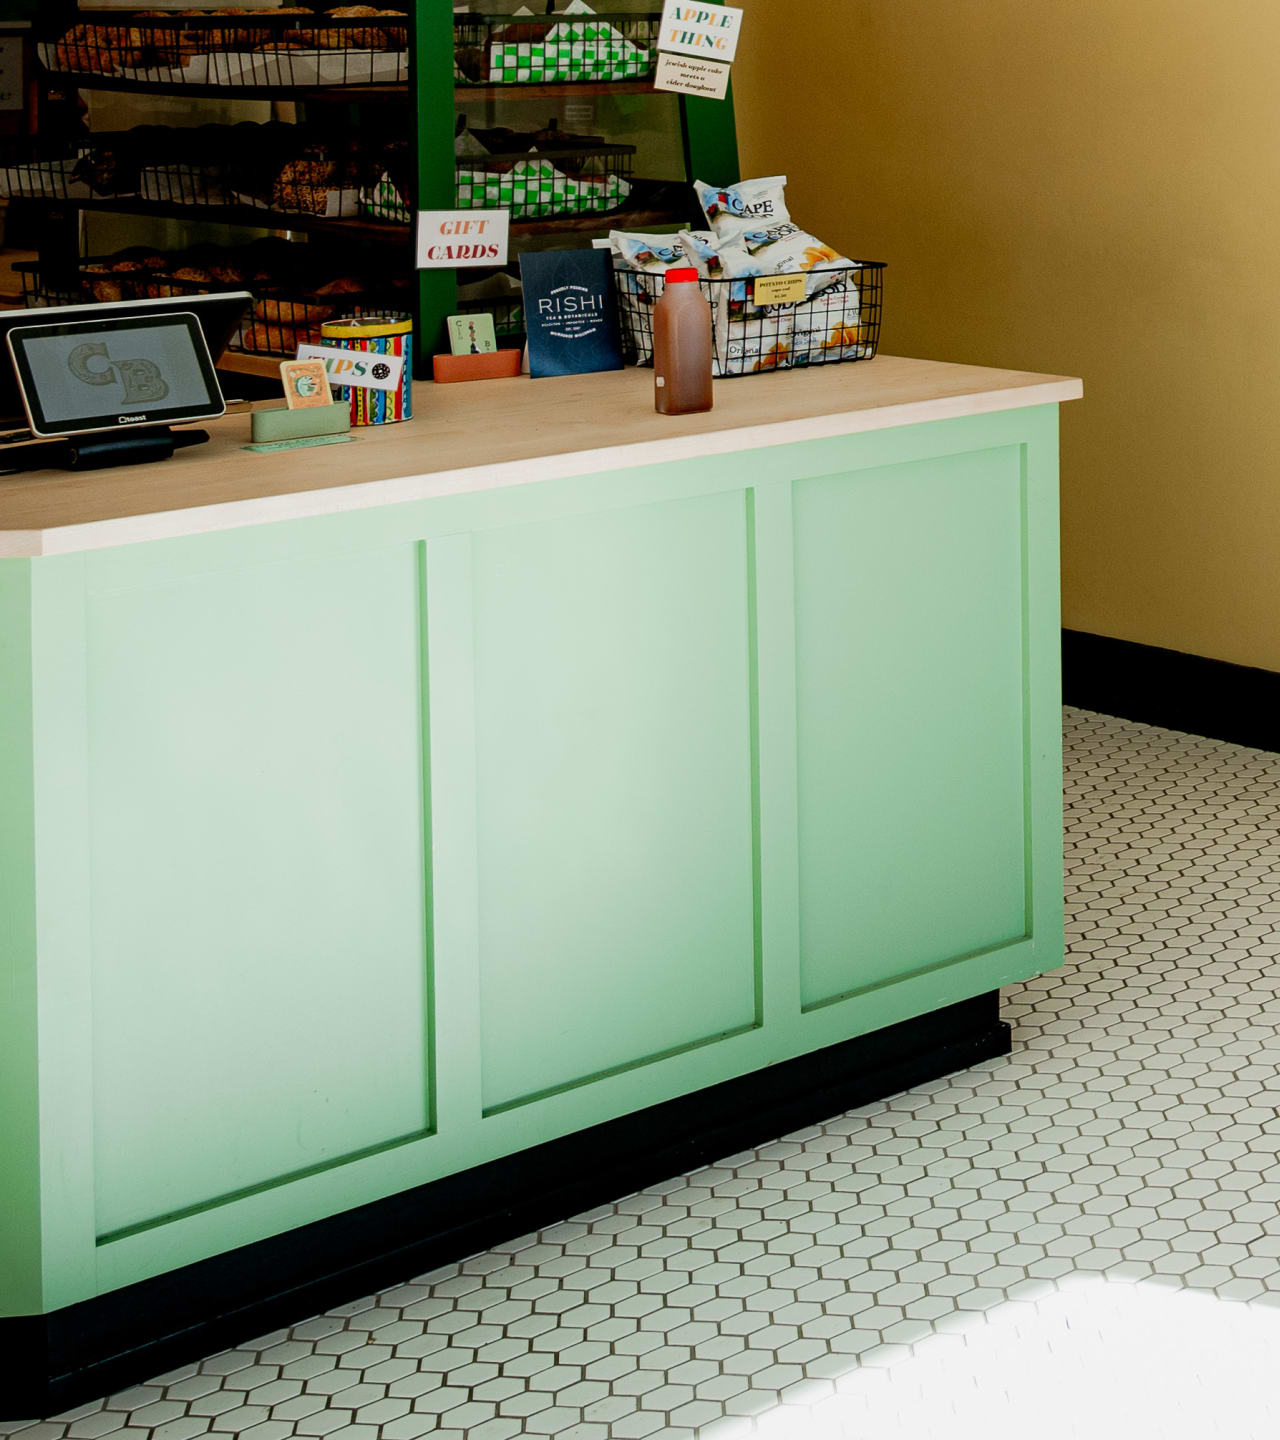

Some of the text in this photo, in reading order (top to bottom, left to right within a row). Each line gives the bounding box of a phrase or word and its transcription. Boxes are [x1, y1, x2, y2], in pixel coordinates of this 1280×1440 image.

[669, 6, 734, 30] APPLE
[669, 28, 727, 51] THING
[439, 219, 491, 237] GIFT
[426, 242, 500, 262] CARDS
[538, 293, 604, 314] RISHI
